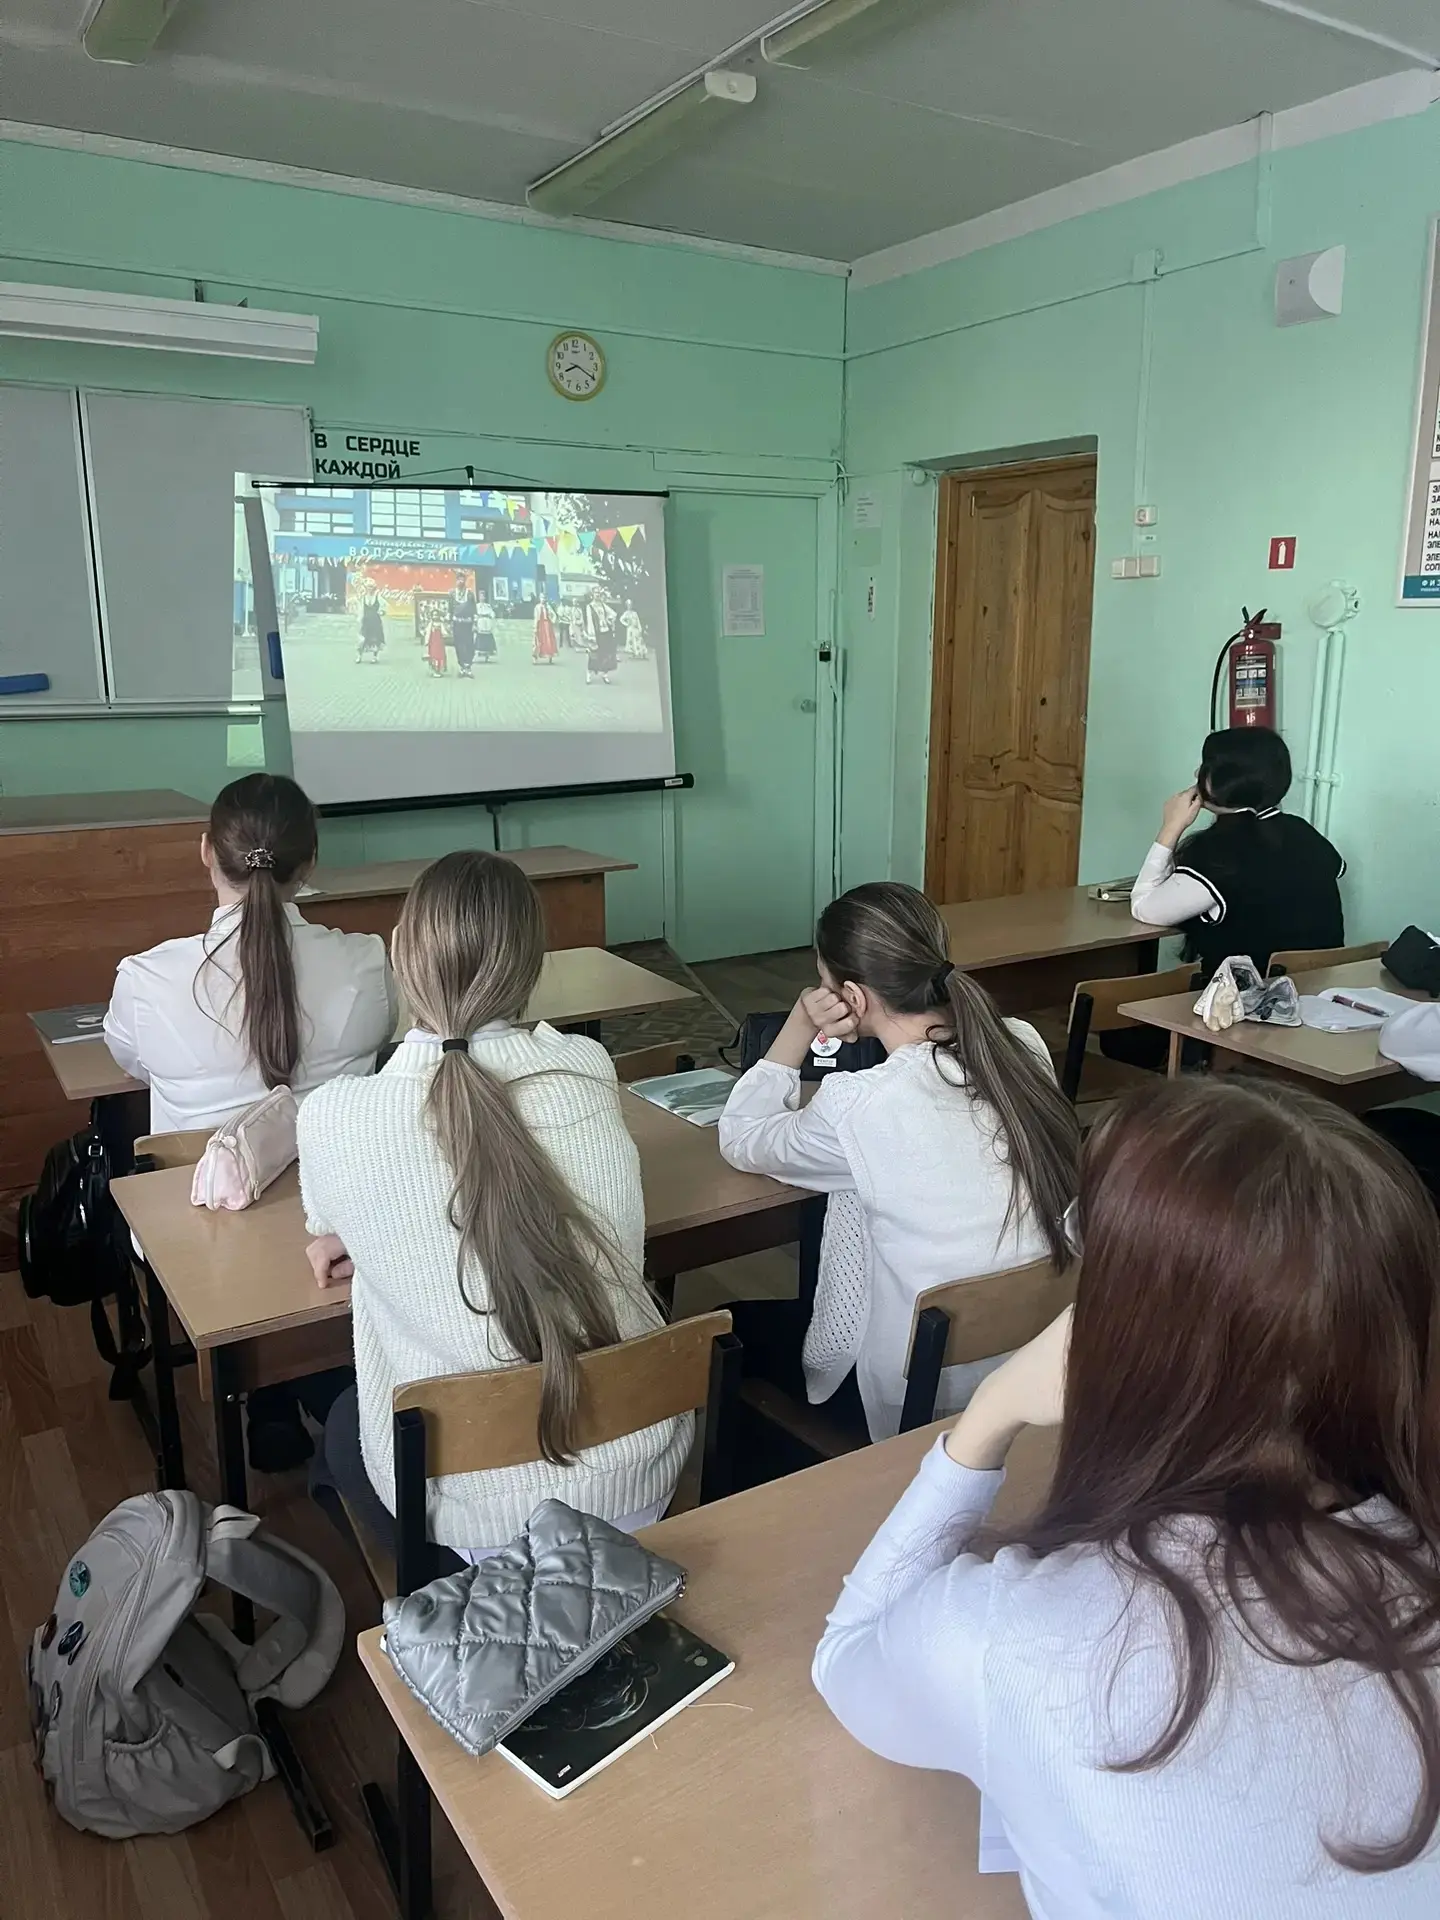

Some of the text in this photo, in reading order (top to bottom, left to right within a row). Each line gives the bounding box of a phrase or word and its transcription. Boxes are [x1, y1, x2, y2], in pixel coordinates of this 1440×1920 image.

[314, 433, 421, 457] В СЕРДЦЕ
[315, 458, 400, 479] КАЖДОЙ
